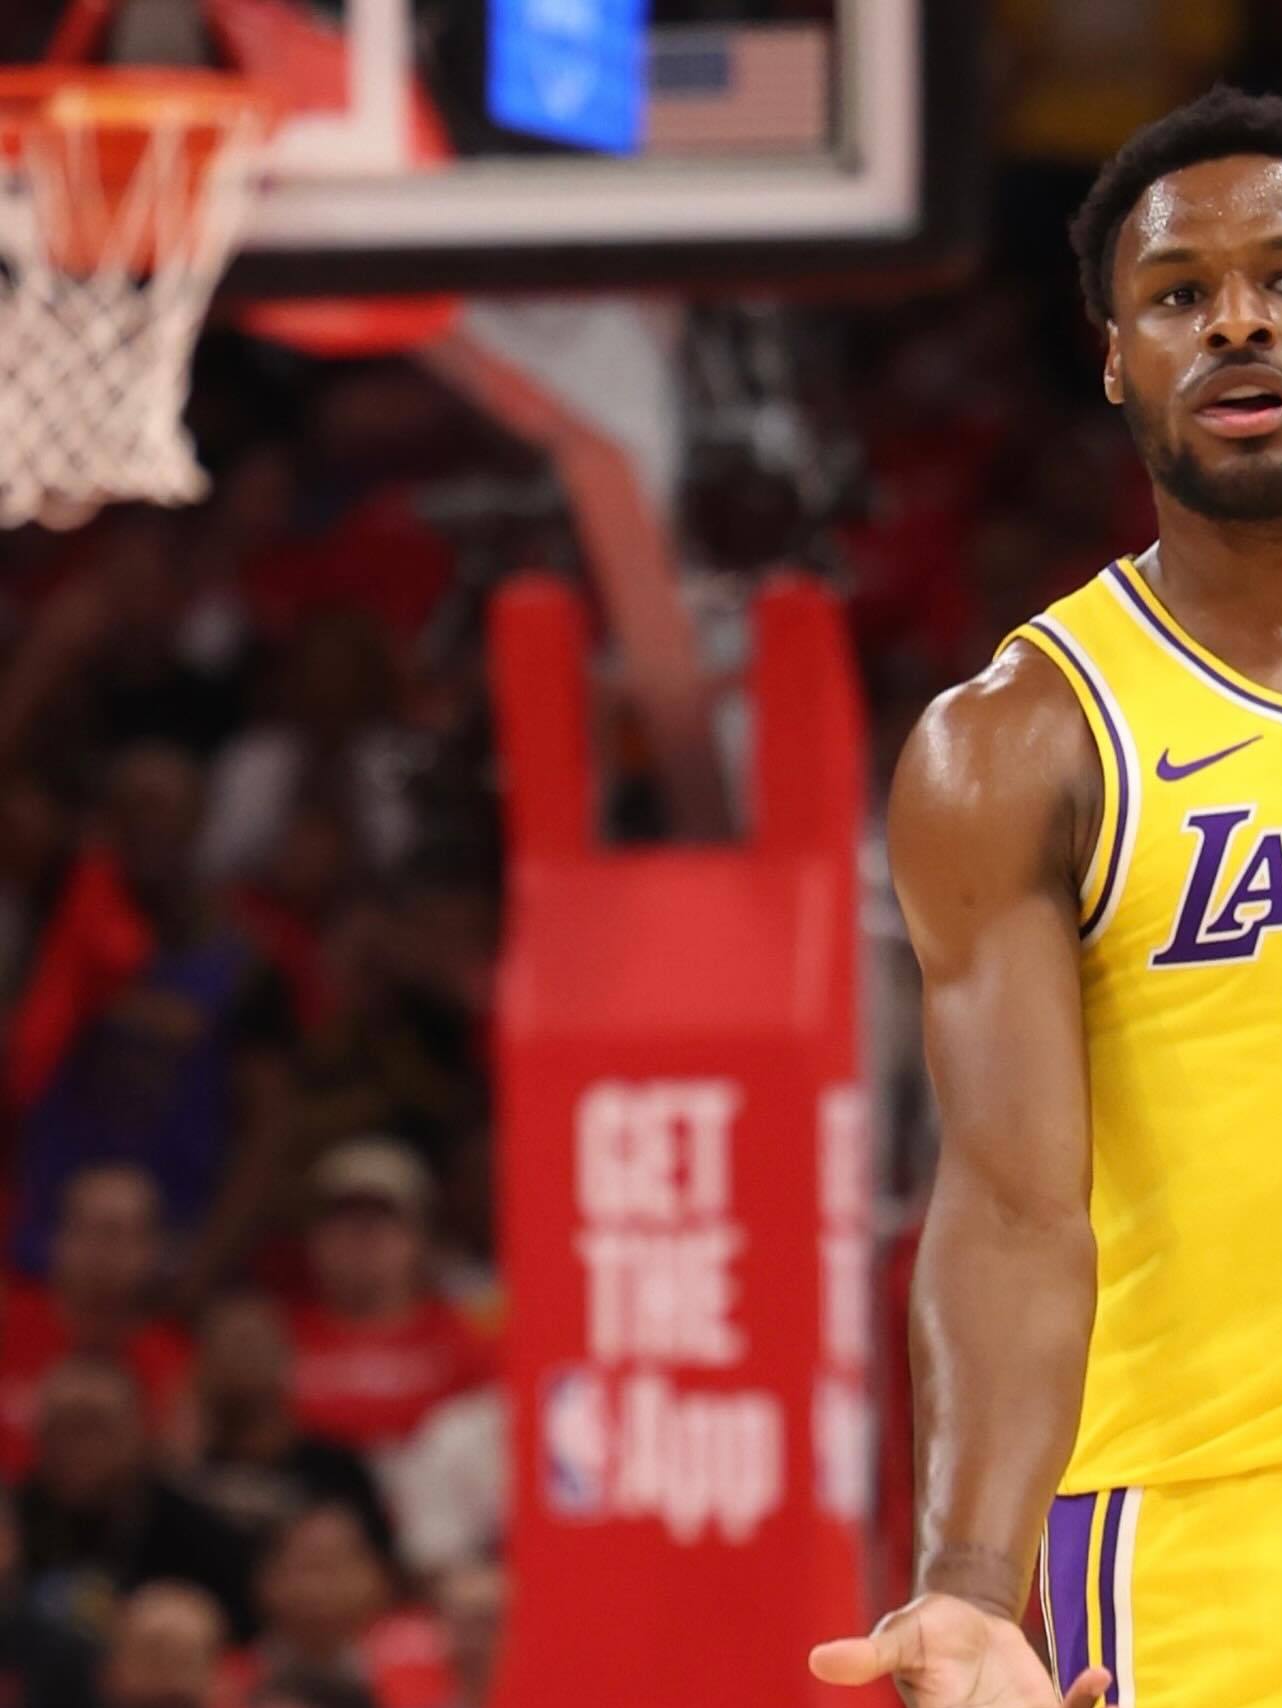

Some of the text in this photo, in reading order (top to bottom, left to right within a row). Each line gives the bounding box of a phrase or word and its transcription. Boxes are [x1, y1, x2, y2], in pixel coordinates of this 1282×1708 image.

[577, 1082, 738, 1220] GET
[577, 1222, 742, 1366] THE
[612, 1370, 785, 1545] App
